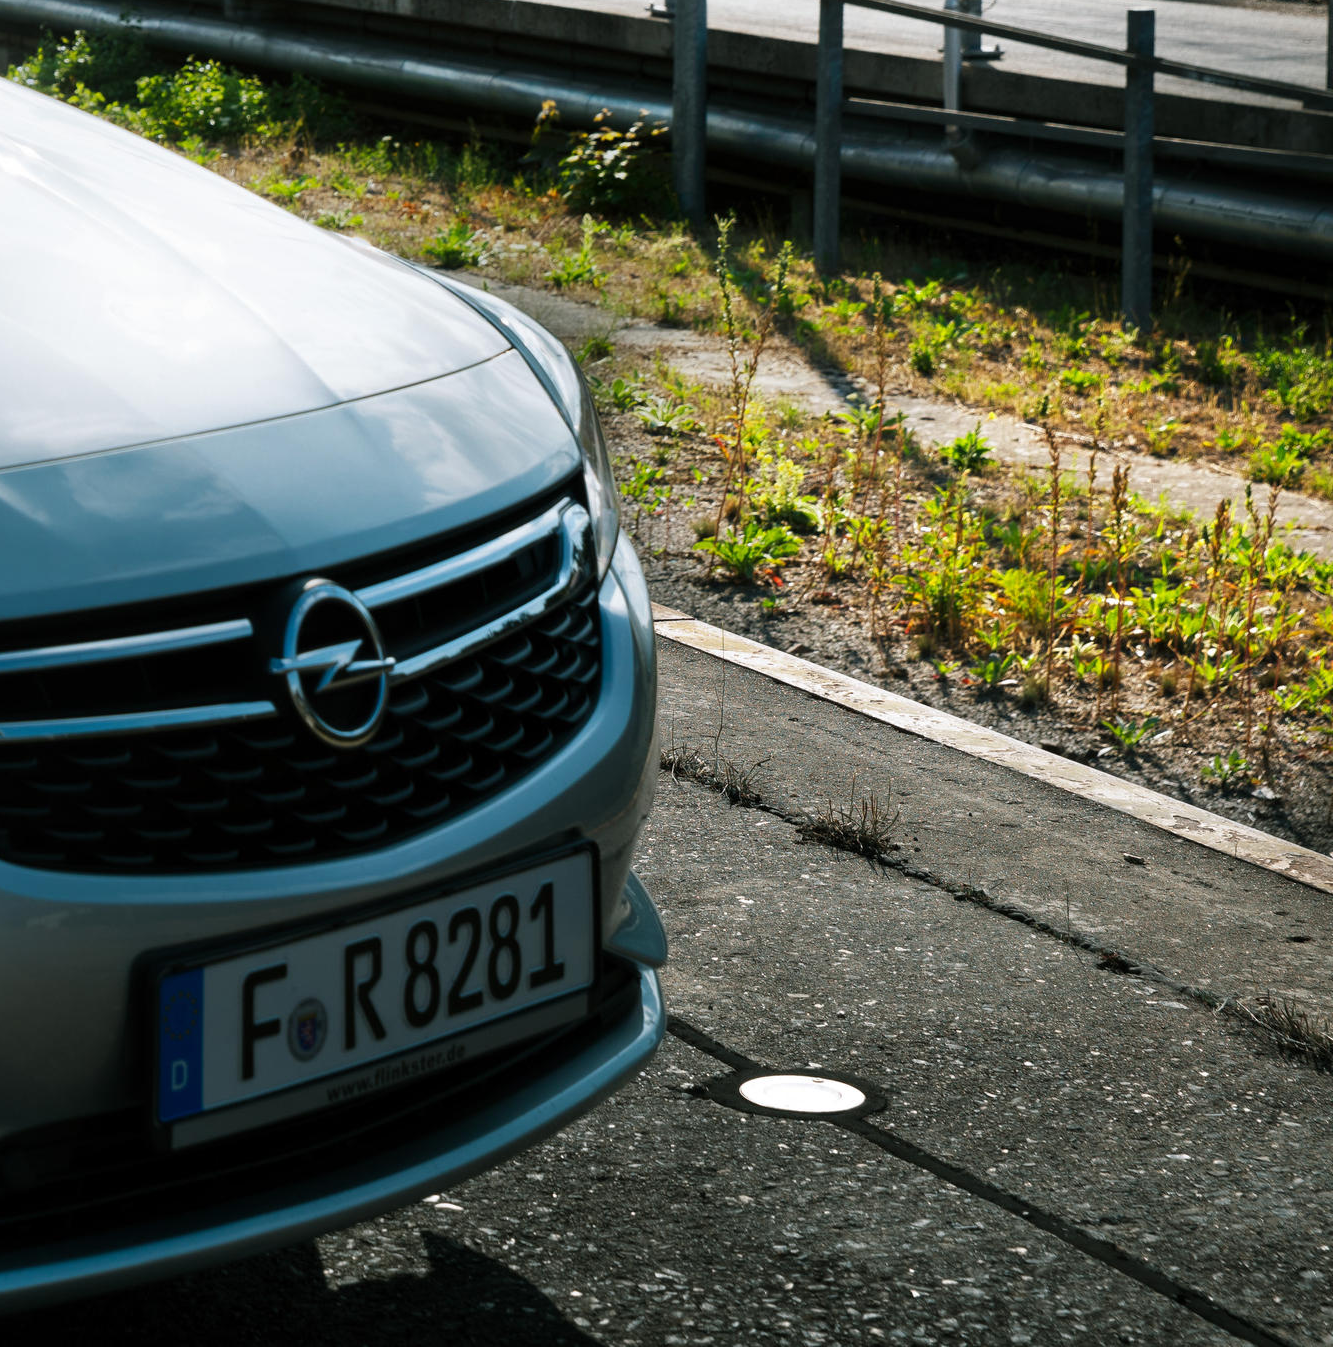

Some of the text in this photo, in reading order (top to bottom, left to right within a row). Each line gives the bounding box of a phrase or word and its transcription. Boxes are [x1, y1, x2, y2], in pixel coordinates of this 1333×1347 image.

[241, 881, 565, 1081] F R 8281
[171, 1060, 188, 1091] D
[326, 1044, 466, 1101] www.flinkster.de
